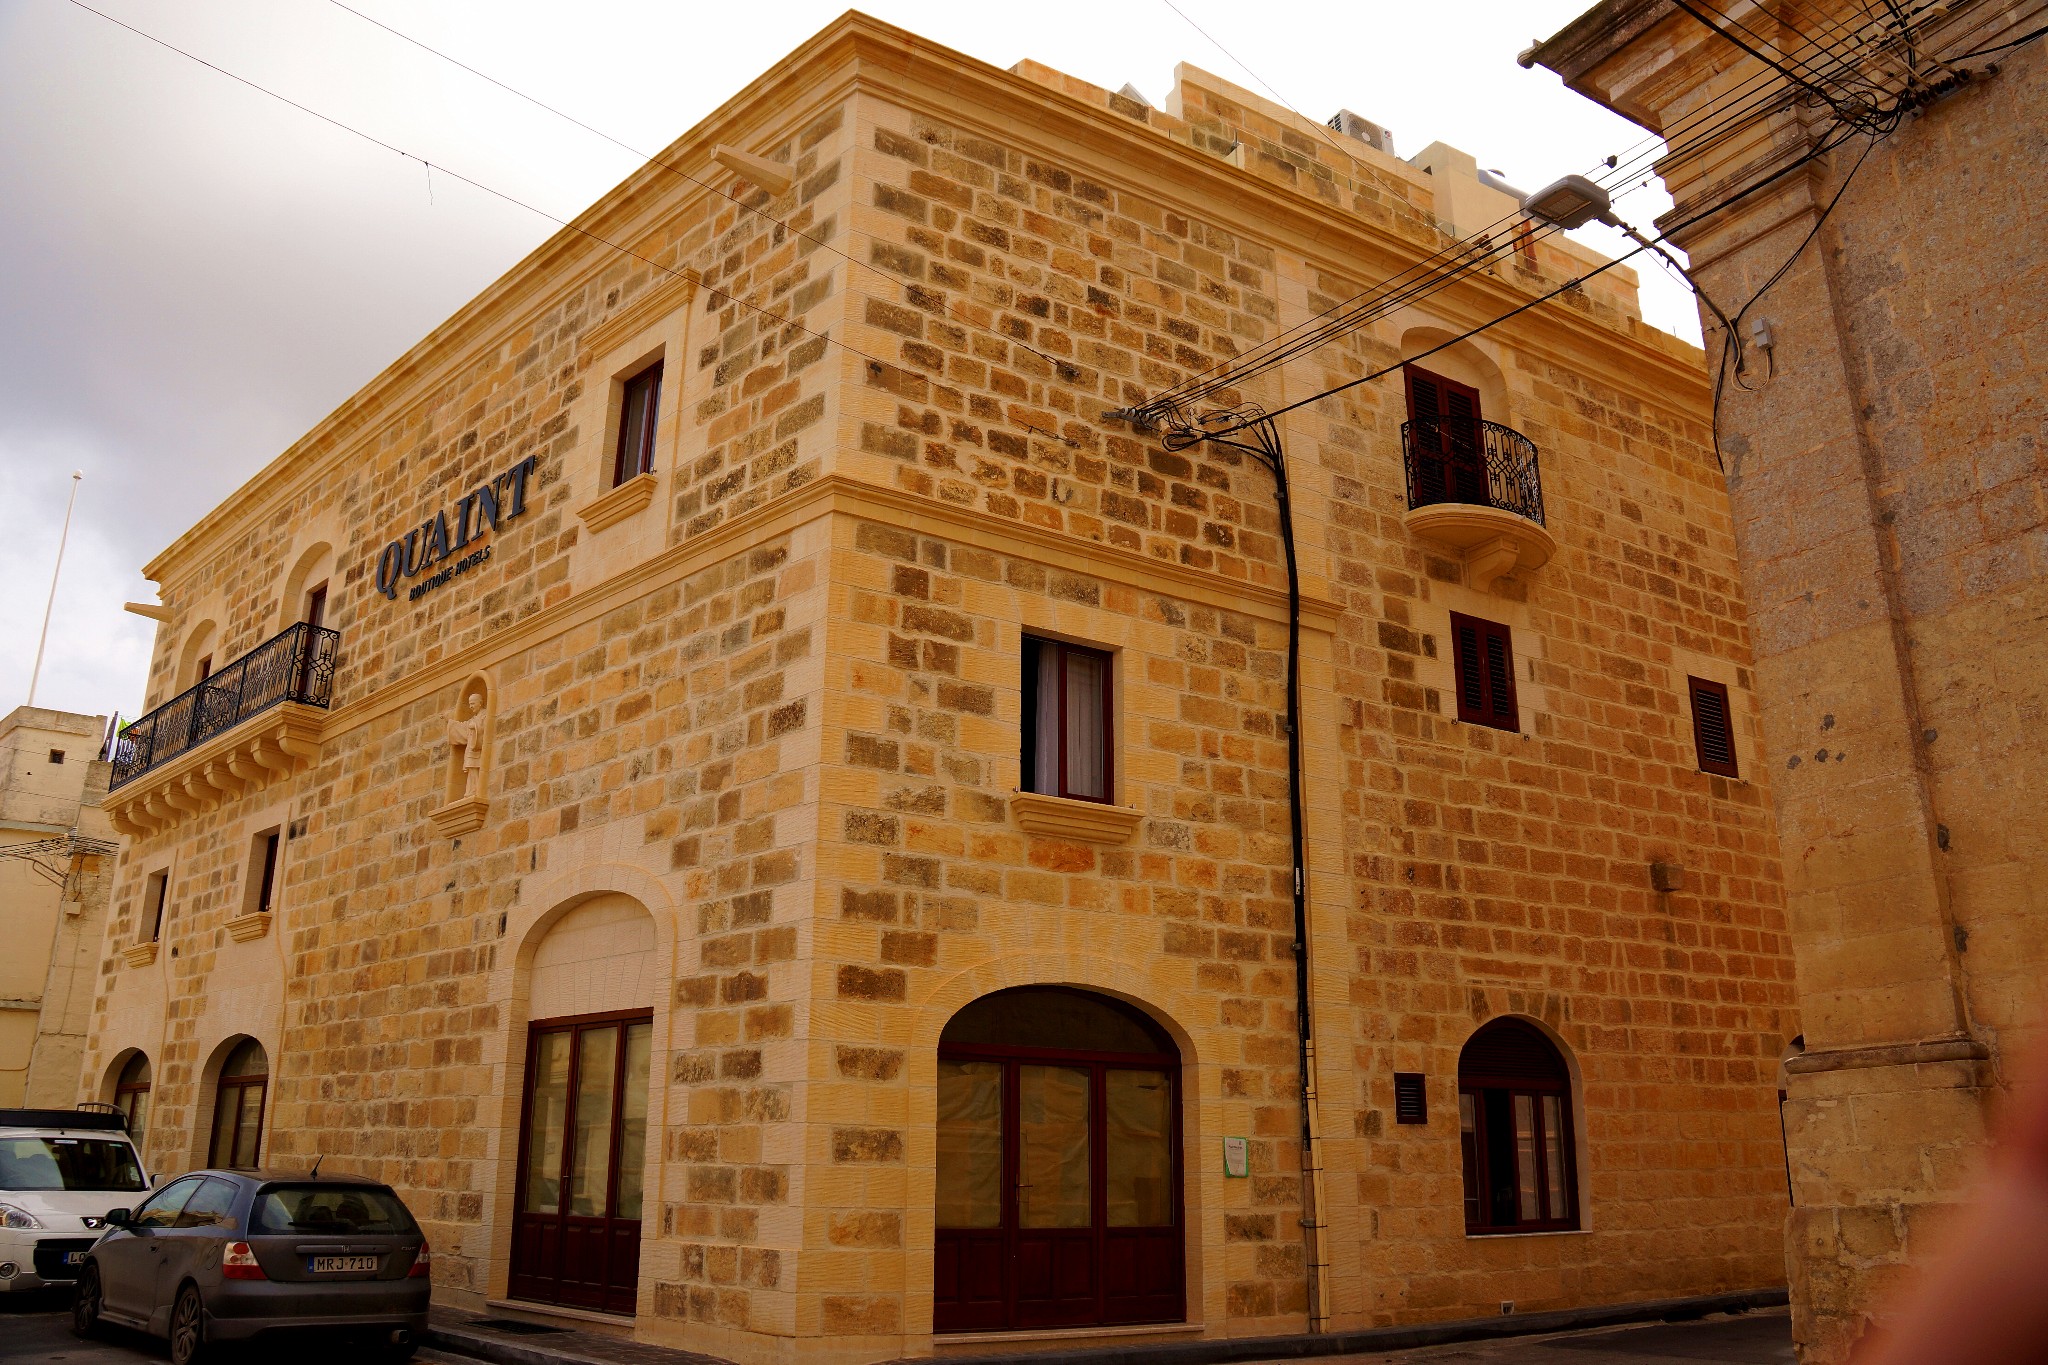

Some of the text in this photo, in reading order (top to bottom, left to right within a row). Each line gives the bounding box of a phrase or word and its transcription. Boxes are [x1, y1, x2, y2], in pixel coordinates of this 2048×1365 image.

[376, 454, 536, 600] QUAINT
[409, 545, 490, 601] BOUTIQUE HOTELS
[317, 1257, 374, 1270] MRJ 710
